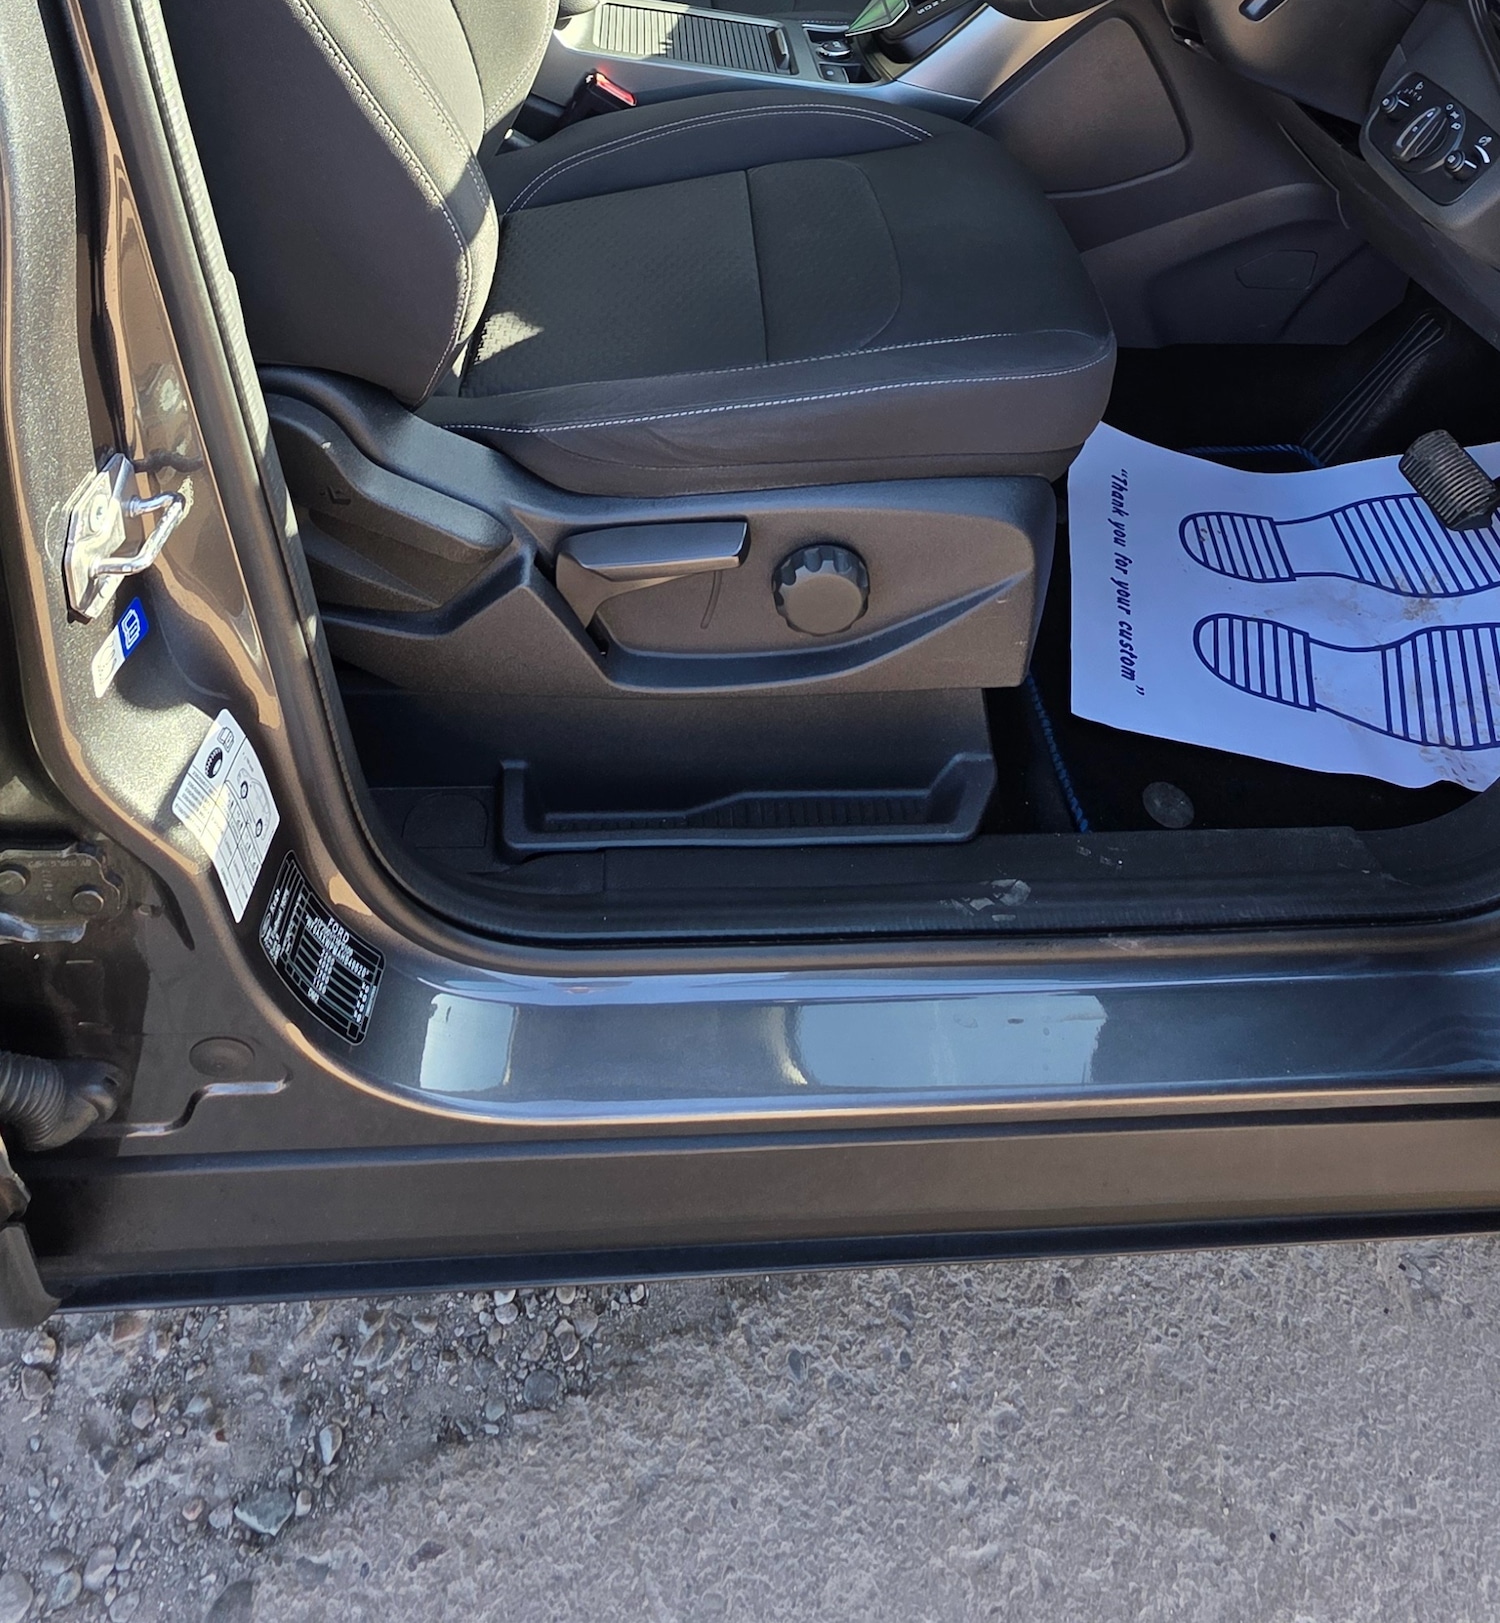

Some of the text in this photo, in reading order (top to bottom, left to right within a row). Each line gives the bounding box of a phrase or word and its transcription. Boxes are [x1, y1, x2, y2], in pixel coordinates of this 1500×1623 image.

[1107, 518, 1126, 547] you
[1114, 552, 1133, 575] for
[1109, 576, 1131, 615] your
[327, 917, 350, 944] FORD
